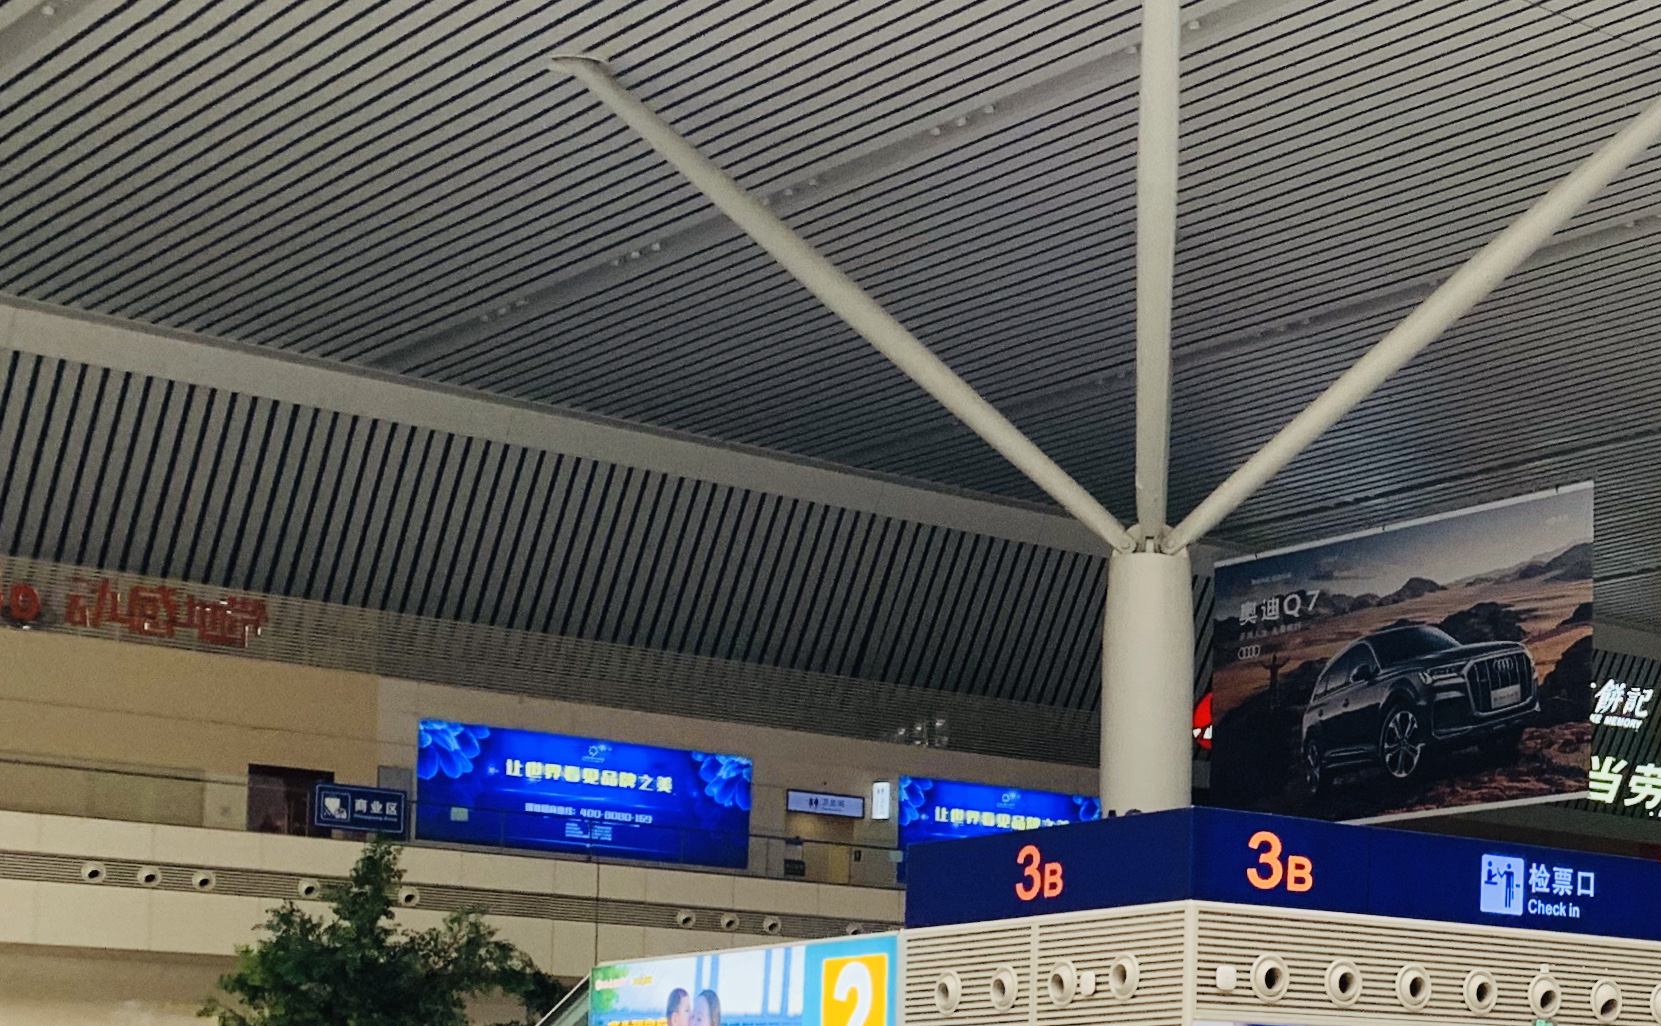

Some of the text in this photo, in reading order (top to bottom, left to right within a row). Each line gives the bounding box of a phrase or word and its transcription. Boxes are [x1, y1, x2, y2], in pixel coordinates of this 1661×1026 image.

[1239, 590, 1320, 626] 奥迪Q7
[1603, 715, 1643, 730] MEMORY
[505, 758, 673, 794] 让世界看见品牌之美
[354, 798, 398, 816] 商业区
[934, 805, 1069, 831] 让世界看见品牌
[1015, 845, 1063, 900] 3B
[1246, 831, 1313, 892] 3B
[1528, 863, 1596, 898] 检票口
[1527, 899, 1581, 918] Check in
